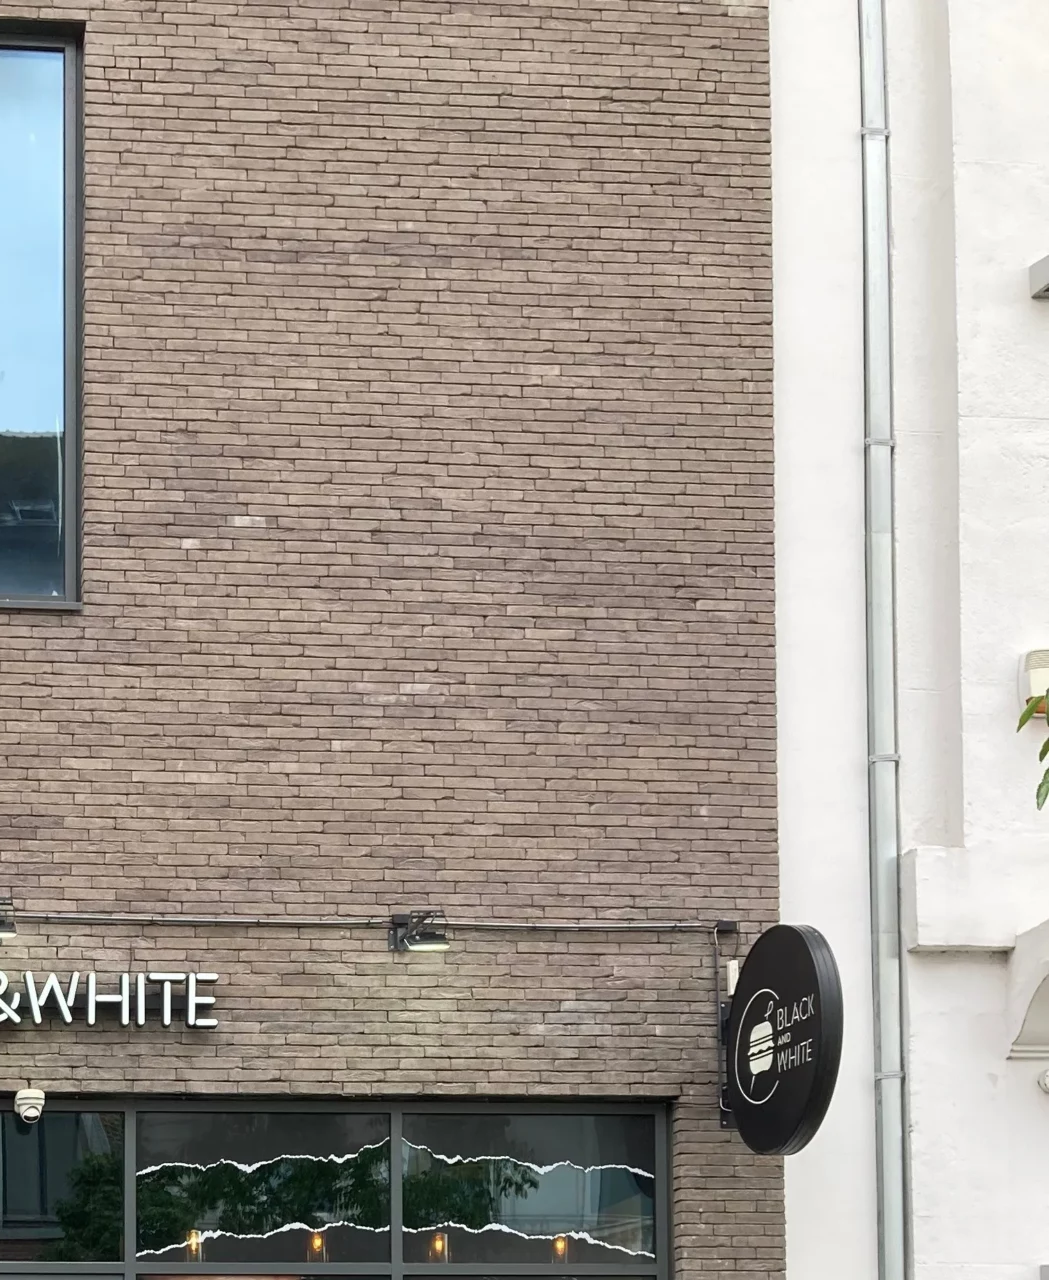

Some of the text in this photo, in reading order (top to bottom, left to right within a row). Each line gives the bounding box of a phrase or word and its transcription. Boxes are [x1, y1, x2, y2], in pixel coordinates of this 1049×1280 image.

[776, 993, 815, 1031] BLACK
[776, 1039, 813, 1073] WHITE
[777, 1032, 792, 1046] AND
